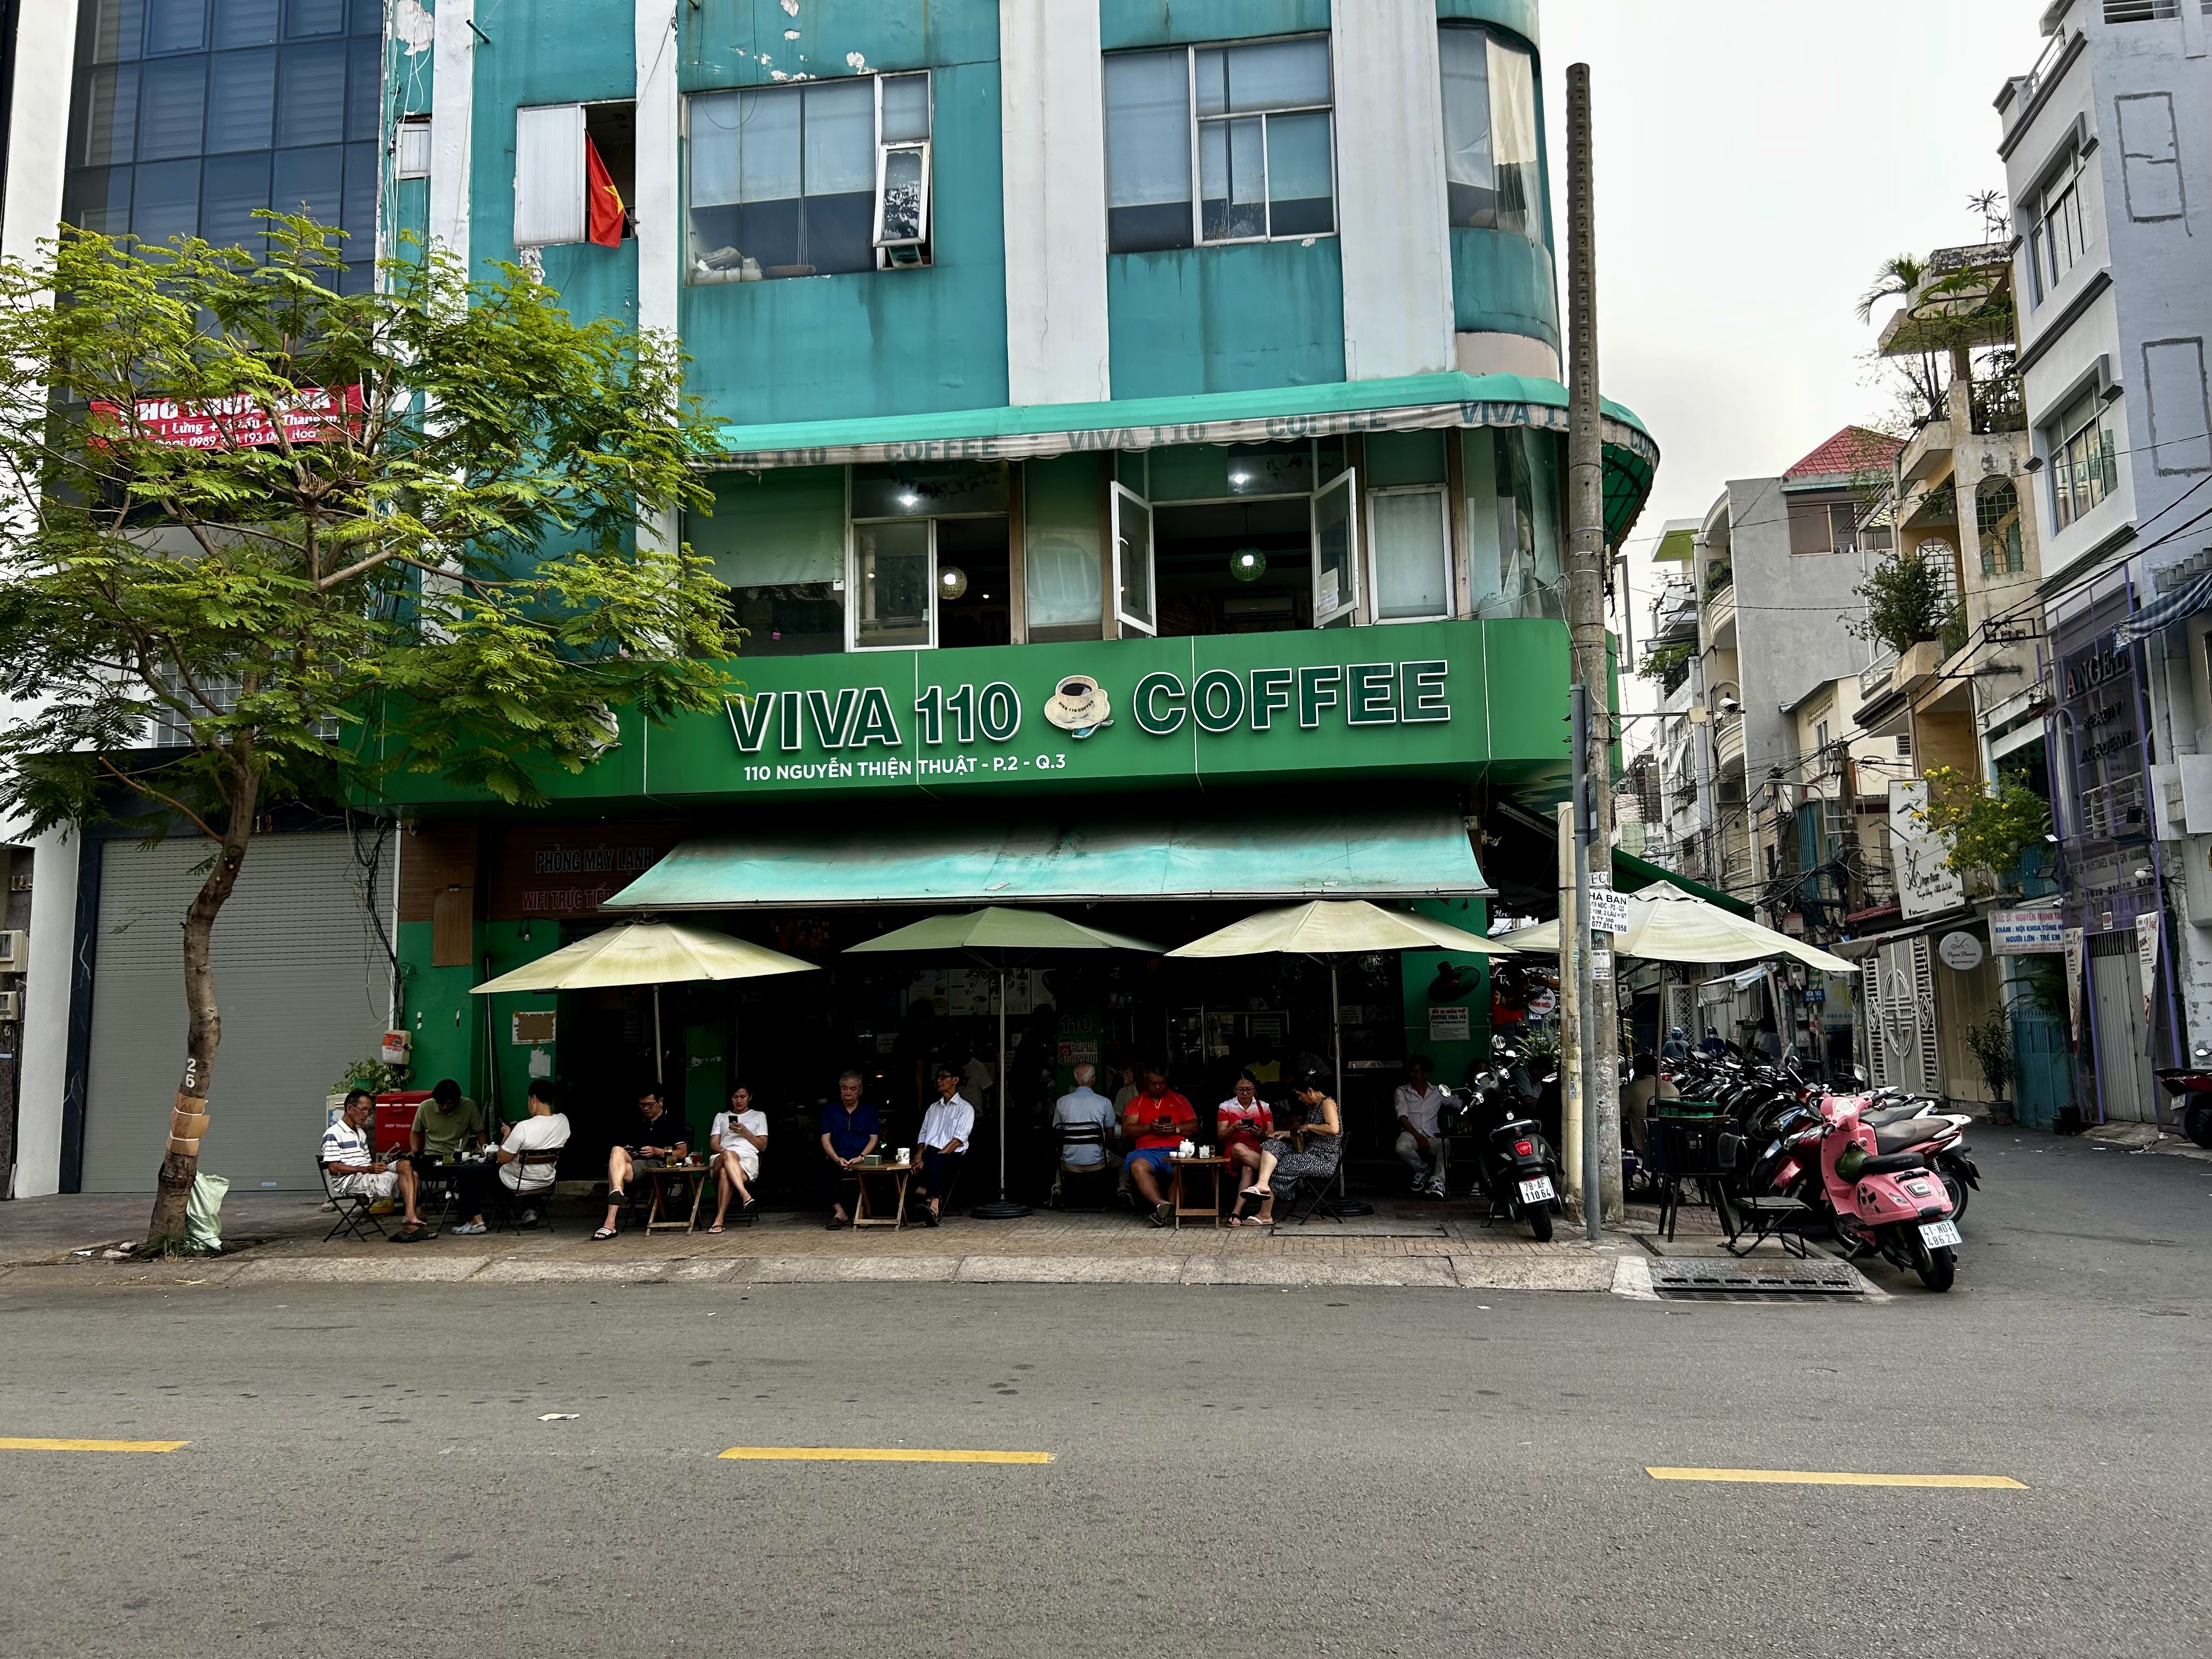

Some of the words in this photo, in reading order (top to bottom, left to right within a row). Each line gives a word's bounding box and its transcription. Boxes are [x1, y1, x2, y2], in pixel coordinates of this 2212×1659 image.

[1459, 402, 1531, 425] VIVA
[161, 424, 166, 435] 1
[189, 436, 216, 447] 0989
[777, 447, 828, 466] 110
[883, 438, 998, 461] COFFEE
[1066, 427, 1138, 451] VIVA
[1149, 423, 1207, 445] 110
[1265, 410, 1388, 437] COFFEE
[724, 687, 902, 752] VIVA
[915, 681, 1022, 745] 110
[1133, 659, 1451, 735] COFFEE
[1078, 700, 1094, 713] COFFEE
[744, 766, 771, 780] 110
[776, 756, 852, 780] NGUYỄN
[857, 758, 912, 778] THIỆN
[917, 754, 978, 775] THUẬT
[993, 756, 1019, 771] P.2
[1036, 754, 1066, 770] Q.3
[535, 844, 581, 873] PHÒNG
[584, 843, 615, 872] MÁY
[617, 848, 653, 876] LẠNH
[522, 891, 549, 910] WIFI
[551, 887, 583, 913] TRỰC
[1059, 1014, 1092, 1034] 110
